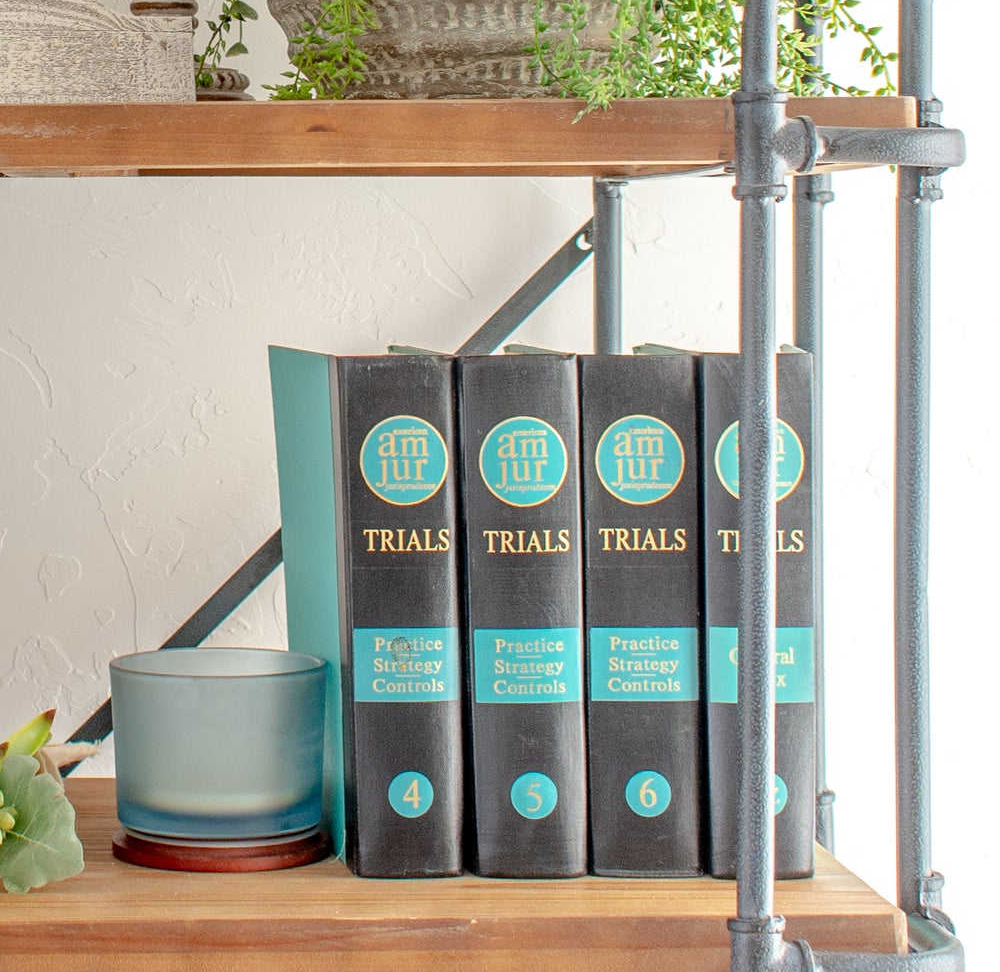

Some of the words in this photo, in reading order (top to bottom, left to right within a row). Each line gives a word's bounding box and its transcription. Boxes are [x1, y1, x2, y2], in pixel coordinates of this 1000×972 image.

[378, 432, 429, 457] am
[497, 433, 549, 458] am
[614, 431, 664, 456] am
[376, 459, 428, 487] jur
[495, 459, 548, 489] jur
[611, 458, 664, 486] jur
[363, 528, 450, 553] TRIALS
[483, 529, 571, 554] TRIALS
[598, 528, 687, 552] TRIALS
[374, 637, 444, 653] Practice
[494, 637, 565, 654] Practice
[609, 635, 680, 652] Practice
[373, 657, 443, 675] Strategy
[494, 659, 564, 676] Strategy
[608, 656, 680, 674] Strategy
[372, 678, 445, 694] Controls
[493, 679, 567, 695] Controls
[607, 677, 682, 693] Controls
[402, 779, 421, 809] 4
[526, 782, 543, 812] 5
[639, 778, 658, 808] 6
